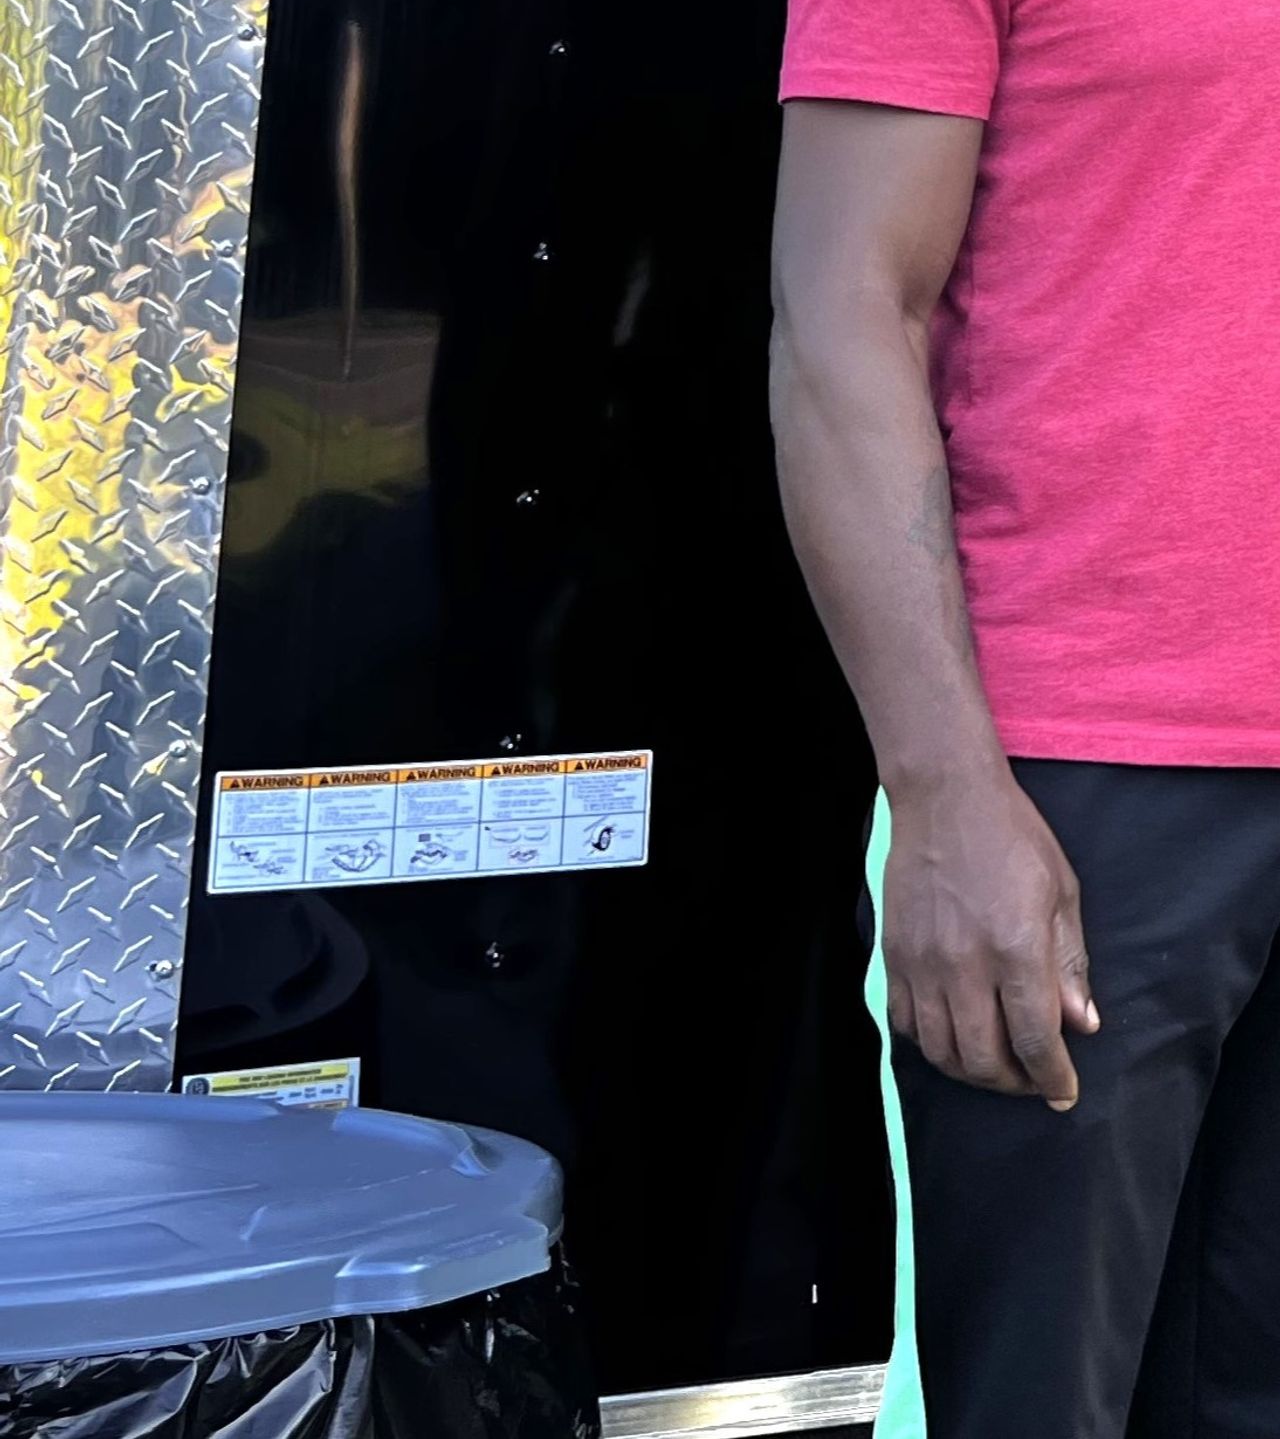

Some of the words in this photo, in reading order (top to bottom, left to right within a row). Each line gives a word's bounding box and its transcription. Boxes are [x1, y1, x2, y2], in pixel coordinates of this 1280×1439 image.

[502, 762, 560, 775] WARNING
[586, 756, 642, 770] WARNING
[331, 771, 391, 784] WARNING
[417, 766, 476, 780] WARNING
[240, 775, 304, 788] WARNING
